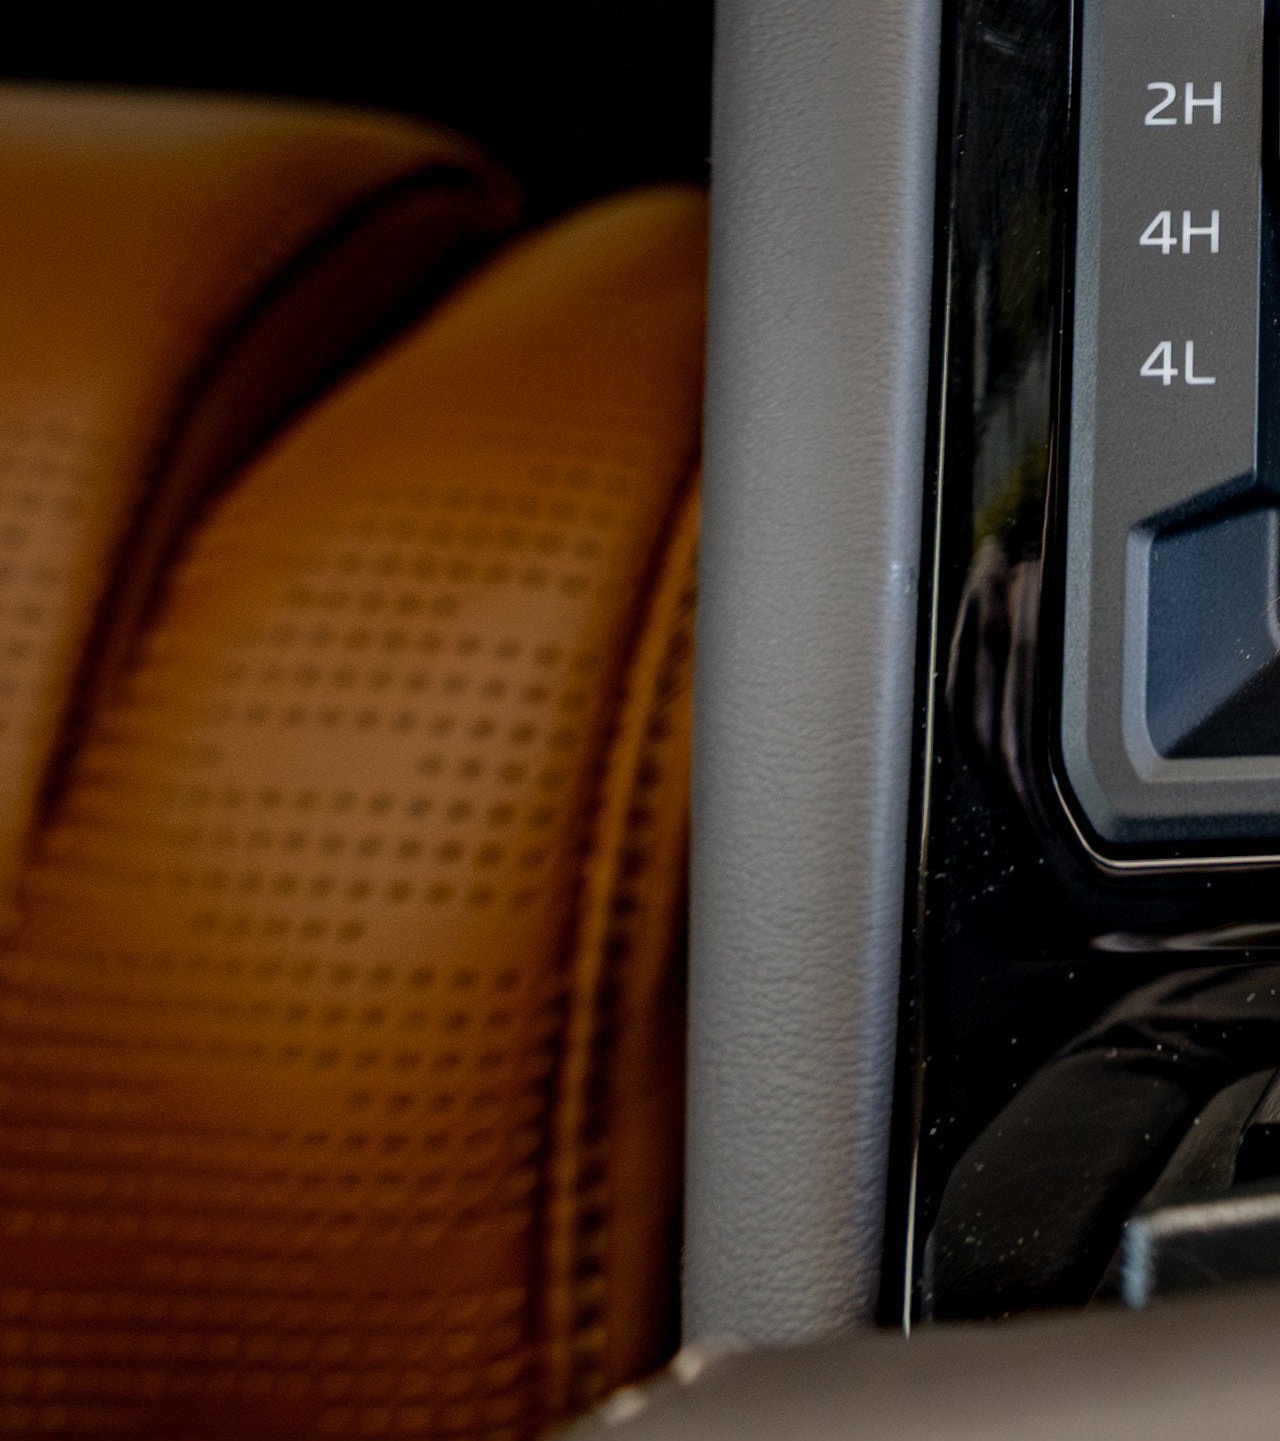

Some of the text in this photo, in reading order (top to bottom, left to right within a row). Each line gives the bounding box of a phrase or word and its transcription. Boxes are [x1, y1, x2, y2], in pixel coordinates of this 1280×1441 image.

[1143, 81, 1223, 126] 2H
[1138, 209, 1221, 255] 4H
[1138, 340, 1217, 386] 4L
